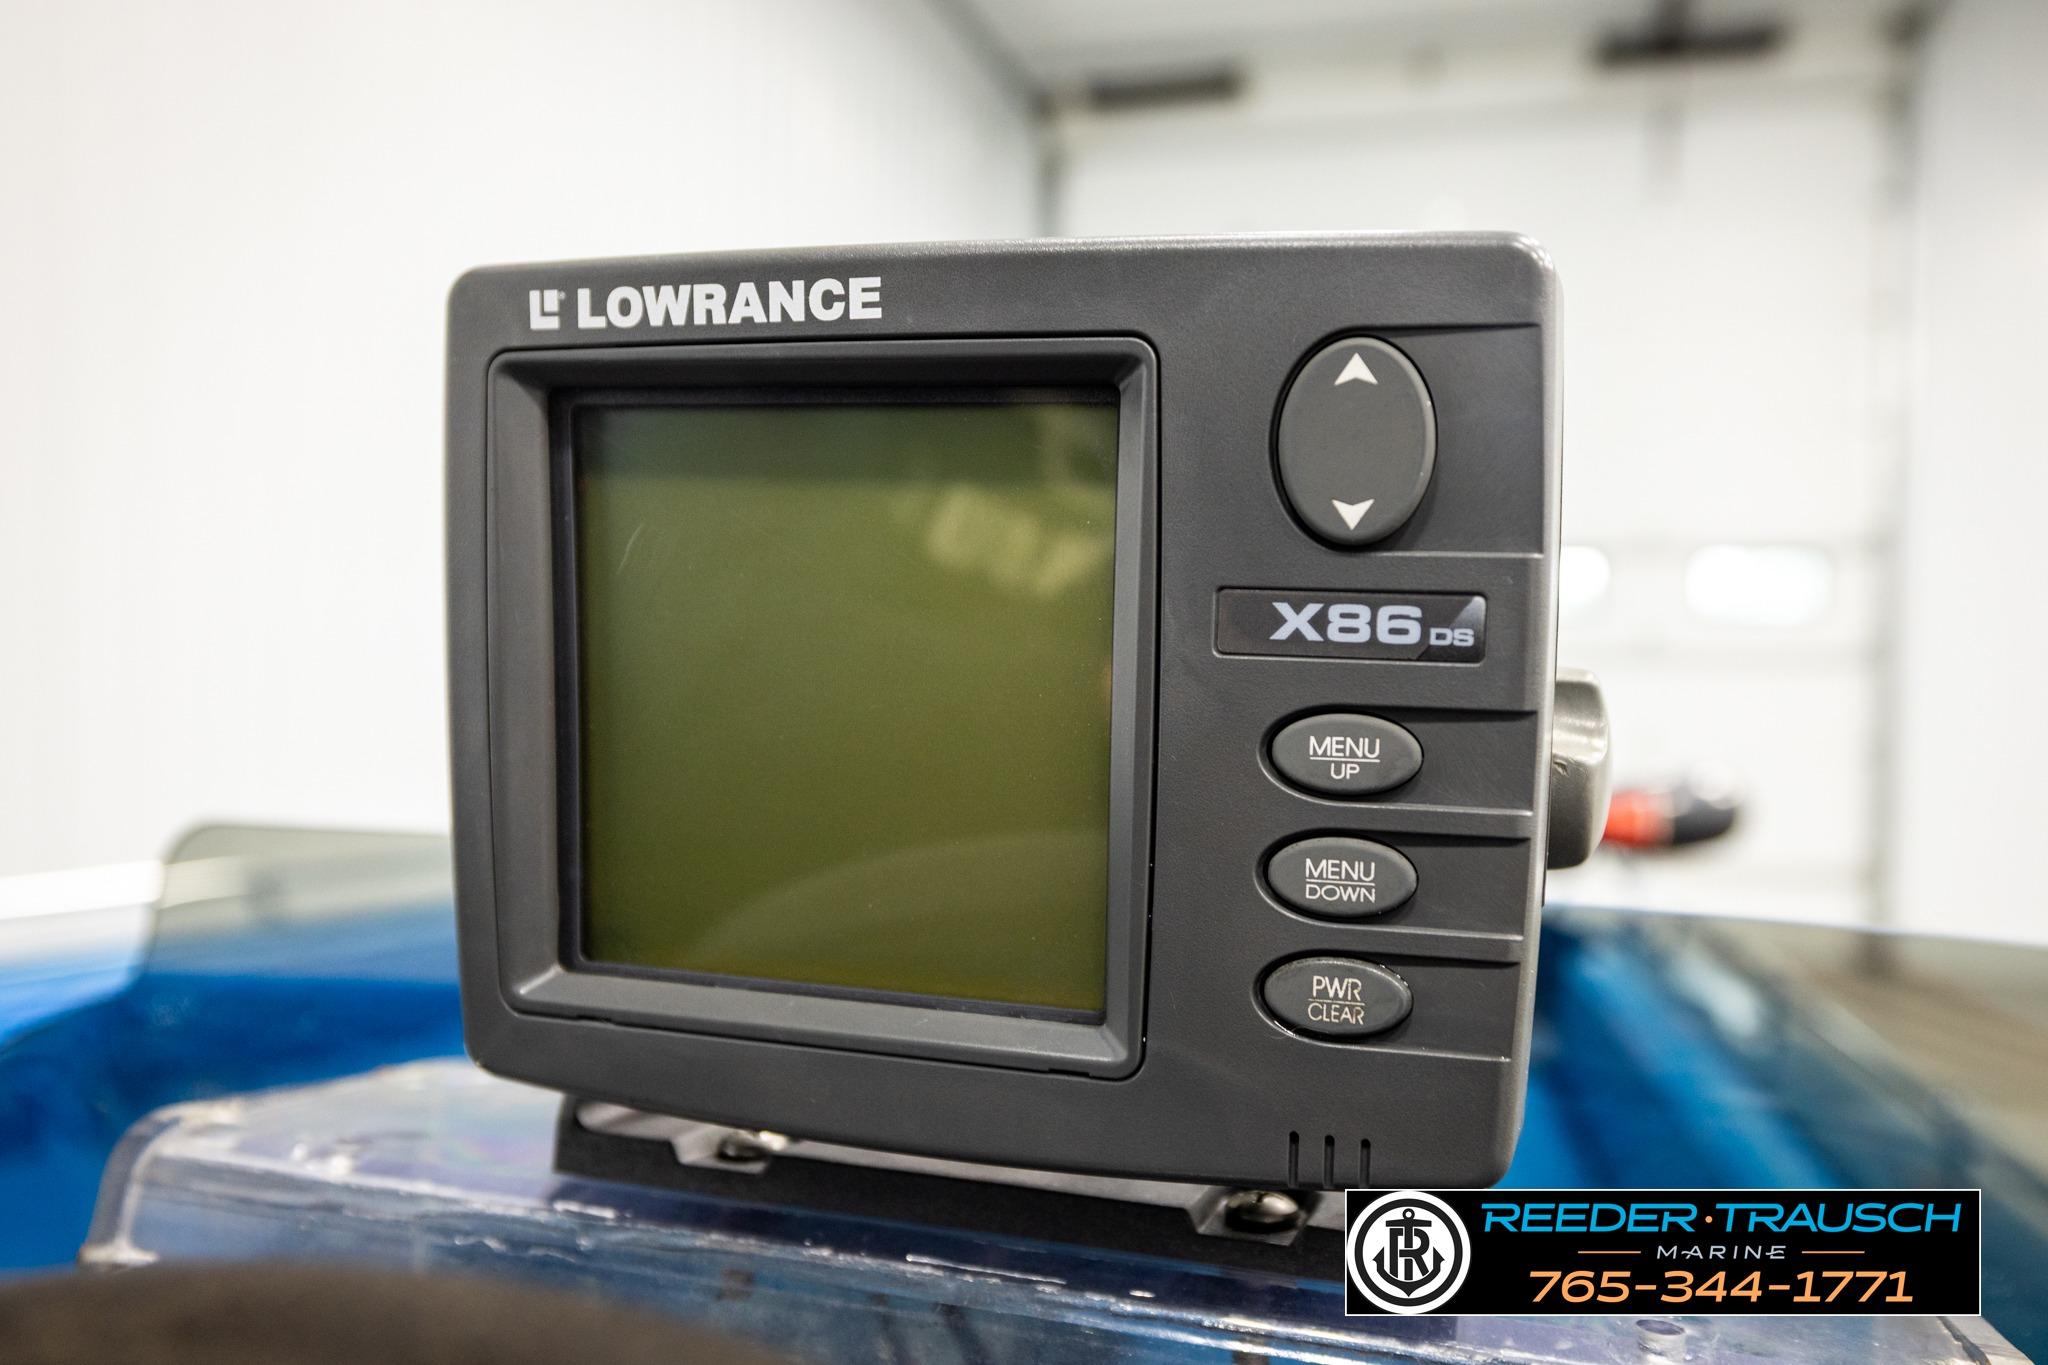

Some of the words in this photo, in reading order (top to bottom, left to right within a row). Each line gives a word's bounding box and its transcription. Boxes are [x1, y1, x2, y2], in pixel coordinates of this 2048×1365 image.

[577, 276, 882, 329] LOWRANCE
[1269, 602, 1422, 645] X86
[1429, 627, 1475, 647] DS
[1309, 735, 1381, 759] MENU
[1330, 763, 1360, 780] UP
[1305, 857, 1376, 882] MENU
[1305, 884, 1376, 904] DOWN
[1312, 975, 1362, 1001] PWR
[1307, 1003, 1365, 1025] CLEAR
